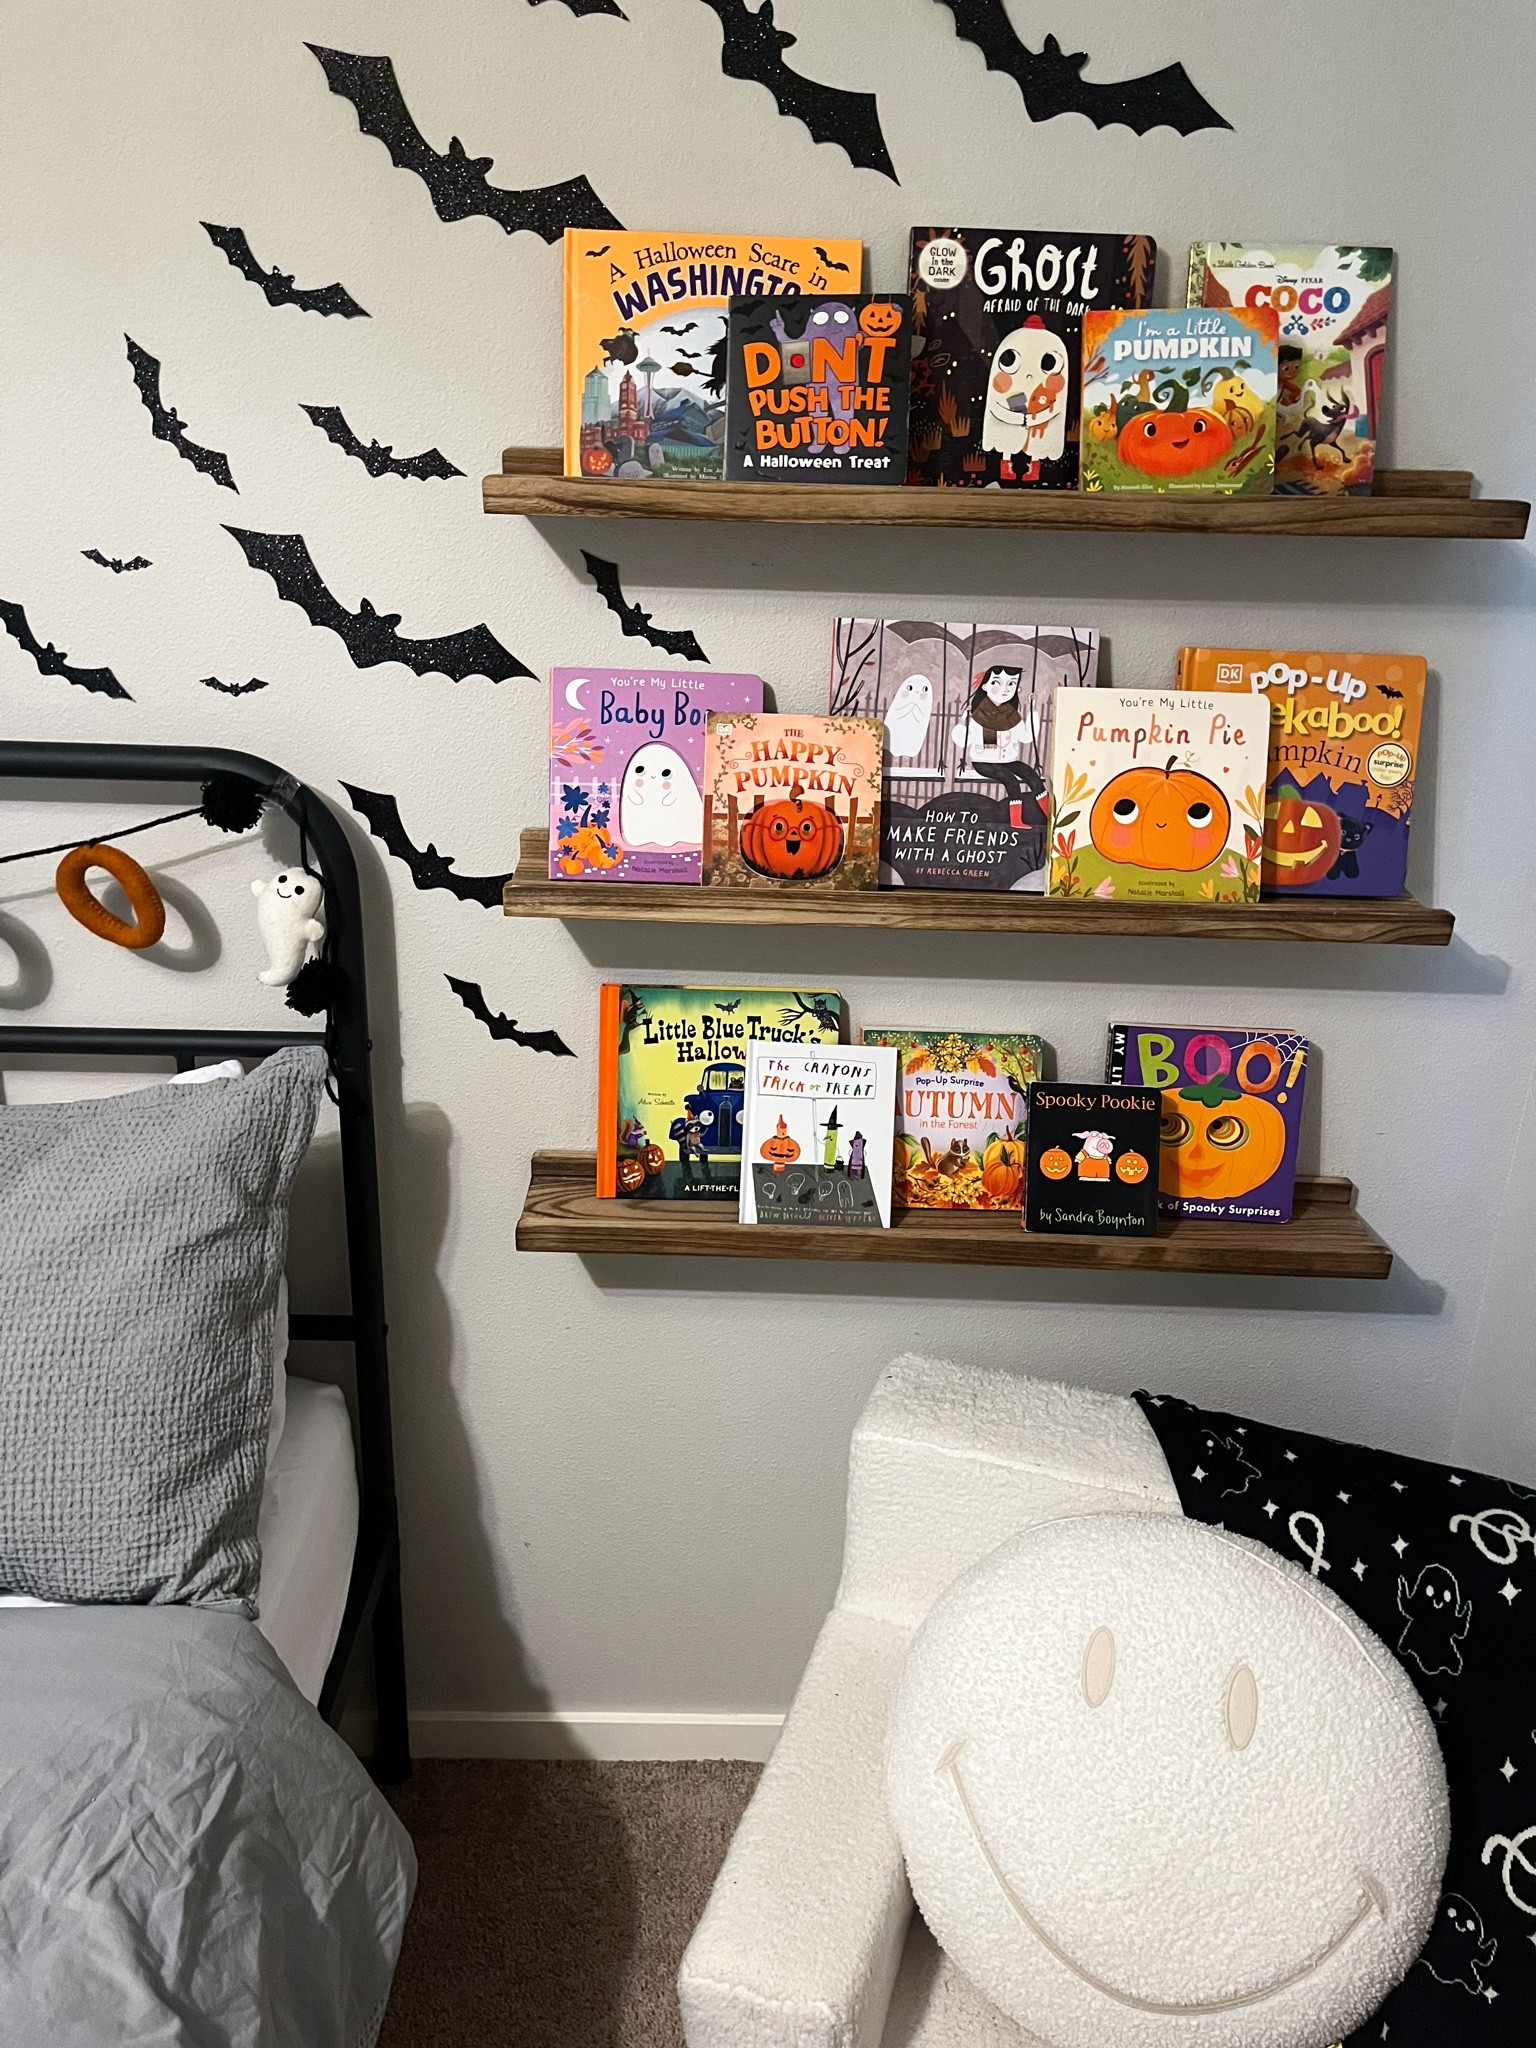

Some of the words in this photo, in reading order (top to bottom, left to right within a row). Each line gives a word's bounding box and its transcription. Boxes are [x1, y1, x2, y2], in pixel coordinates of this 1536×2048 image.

[930, 247, 957, 257] GLOW
[932, 256, 939, 265] in
[941, 258, 953, 266] the
[610, 263, 626, 284] A
[634, 242, 737, 270] Halloween
[749, 243, 801, 275] Scare
[808, 267, 828, 291] in
[928, 266, 956, 276] DARK
[613, 264, 802, 321] WASHINGT
[1245, 285, 1351, 315] COCO
[983, 300, 1021, 312] AFRAID
[1027, 297, 1039, 311] OF
[1044, 298, 1060, 313] THE
[1137, 321, 1161, 337] I'm
[1167, 327, 1180, 336] a
[1186, 318, 1226, 336] Little
[1114, 336, 1252, 361] PUMPKIN
[748, 386, 828, 417] PUSH
[838, 386, 891, 411] THE
[756, 416, 889, 450] BUTTON!
[743, 455, 753, 468] A
[760, 455, 842, 468] Halloween
[849, 455, 891, 469] Treat
[611, 676, 645, 687] You're
[651, 677, 666, 690] My
[671, 678, 705, 690] Little
[1221, 668, 1240, 679] DK
[1119, 697, 1154, 707] You're
[1160, 698, 1175, 710] My
[1180, 698, 1214, 710] Little
[601, 690, 665, 738] Baby
[674, 691, 713, 726] Bo
[784, 729, 804, 738] THE
[1077, 711, 1190, 758] Pumpkin
[1209, 713, 1246, 745] Pie
[750, 738, 842, 766] HAPPY
[1268, 740, 1362, 774] mpkin
[1373, 760, 1404, 768] surprise
[734, 765, 856, 796] PUMPKIN
[925, 810, 956, 823] HOW
[960, 811, 978, 824] TO
[887, 825, 937, 842] MAKE
[944, 828, 1019, 846] FRIENDS
[895, 847, 934, 861] WITH
[941, 849, 950, 862] A
[956, 849, 1007, 864] GHOST
[927, 867, 961, 876] REBECCA
[963, 869, 990, 877] GREEN
[643, 1017, 697, 1044] Little
[702, 1015, 744, 1039] Blue
[1114, 1032, 1126, 1055] MY
[769, 1060, 790, 1071] The
[804, 1062, 872, 1078] CRAYONS
[1137, 1033, 1305, 1104] BOO!
[763, 1075, 806, 1092] TRICK
[826, 1082, 873, 1096] TREAT
[916, 1076, 948, 1087] Pop-Up
[950, 1076, 985, 1087] Surprise
[1036, 1091, 1097, 1111] Spooky
[1101, 1094, 1156, 1110] Pookie
[920, 1119, 928, 1128] in
[930, 1119, 945, 1128] the
[948, 1120, 979, 1129] Forest
[1040, 1208, 1052, 1225] by
[1055, 1207, 1094, 1224] Sandra
[1095, 1209, 1145, 1229] Boynton
[1167, 1200, 1180, 1210] of
[1182, 1201, 1225, 1216] Spooky
[1228, 1204, 1281, 1217] Surprises
